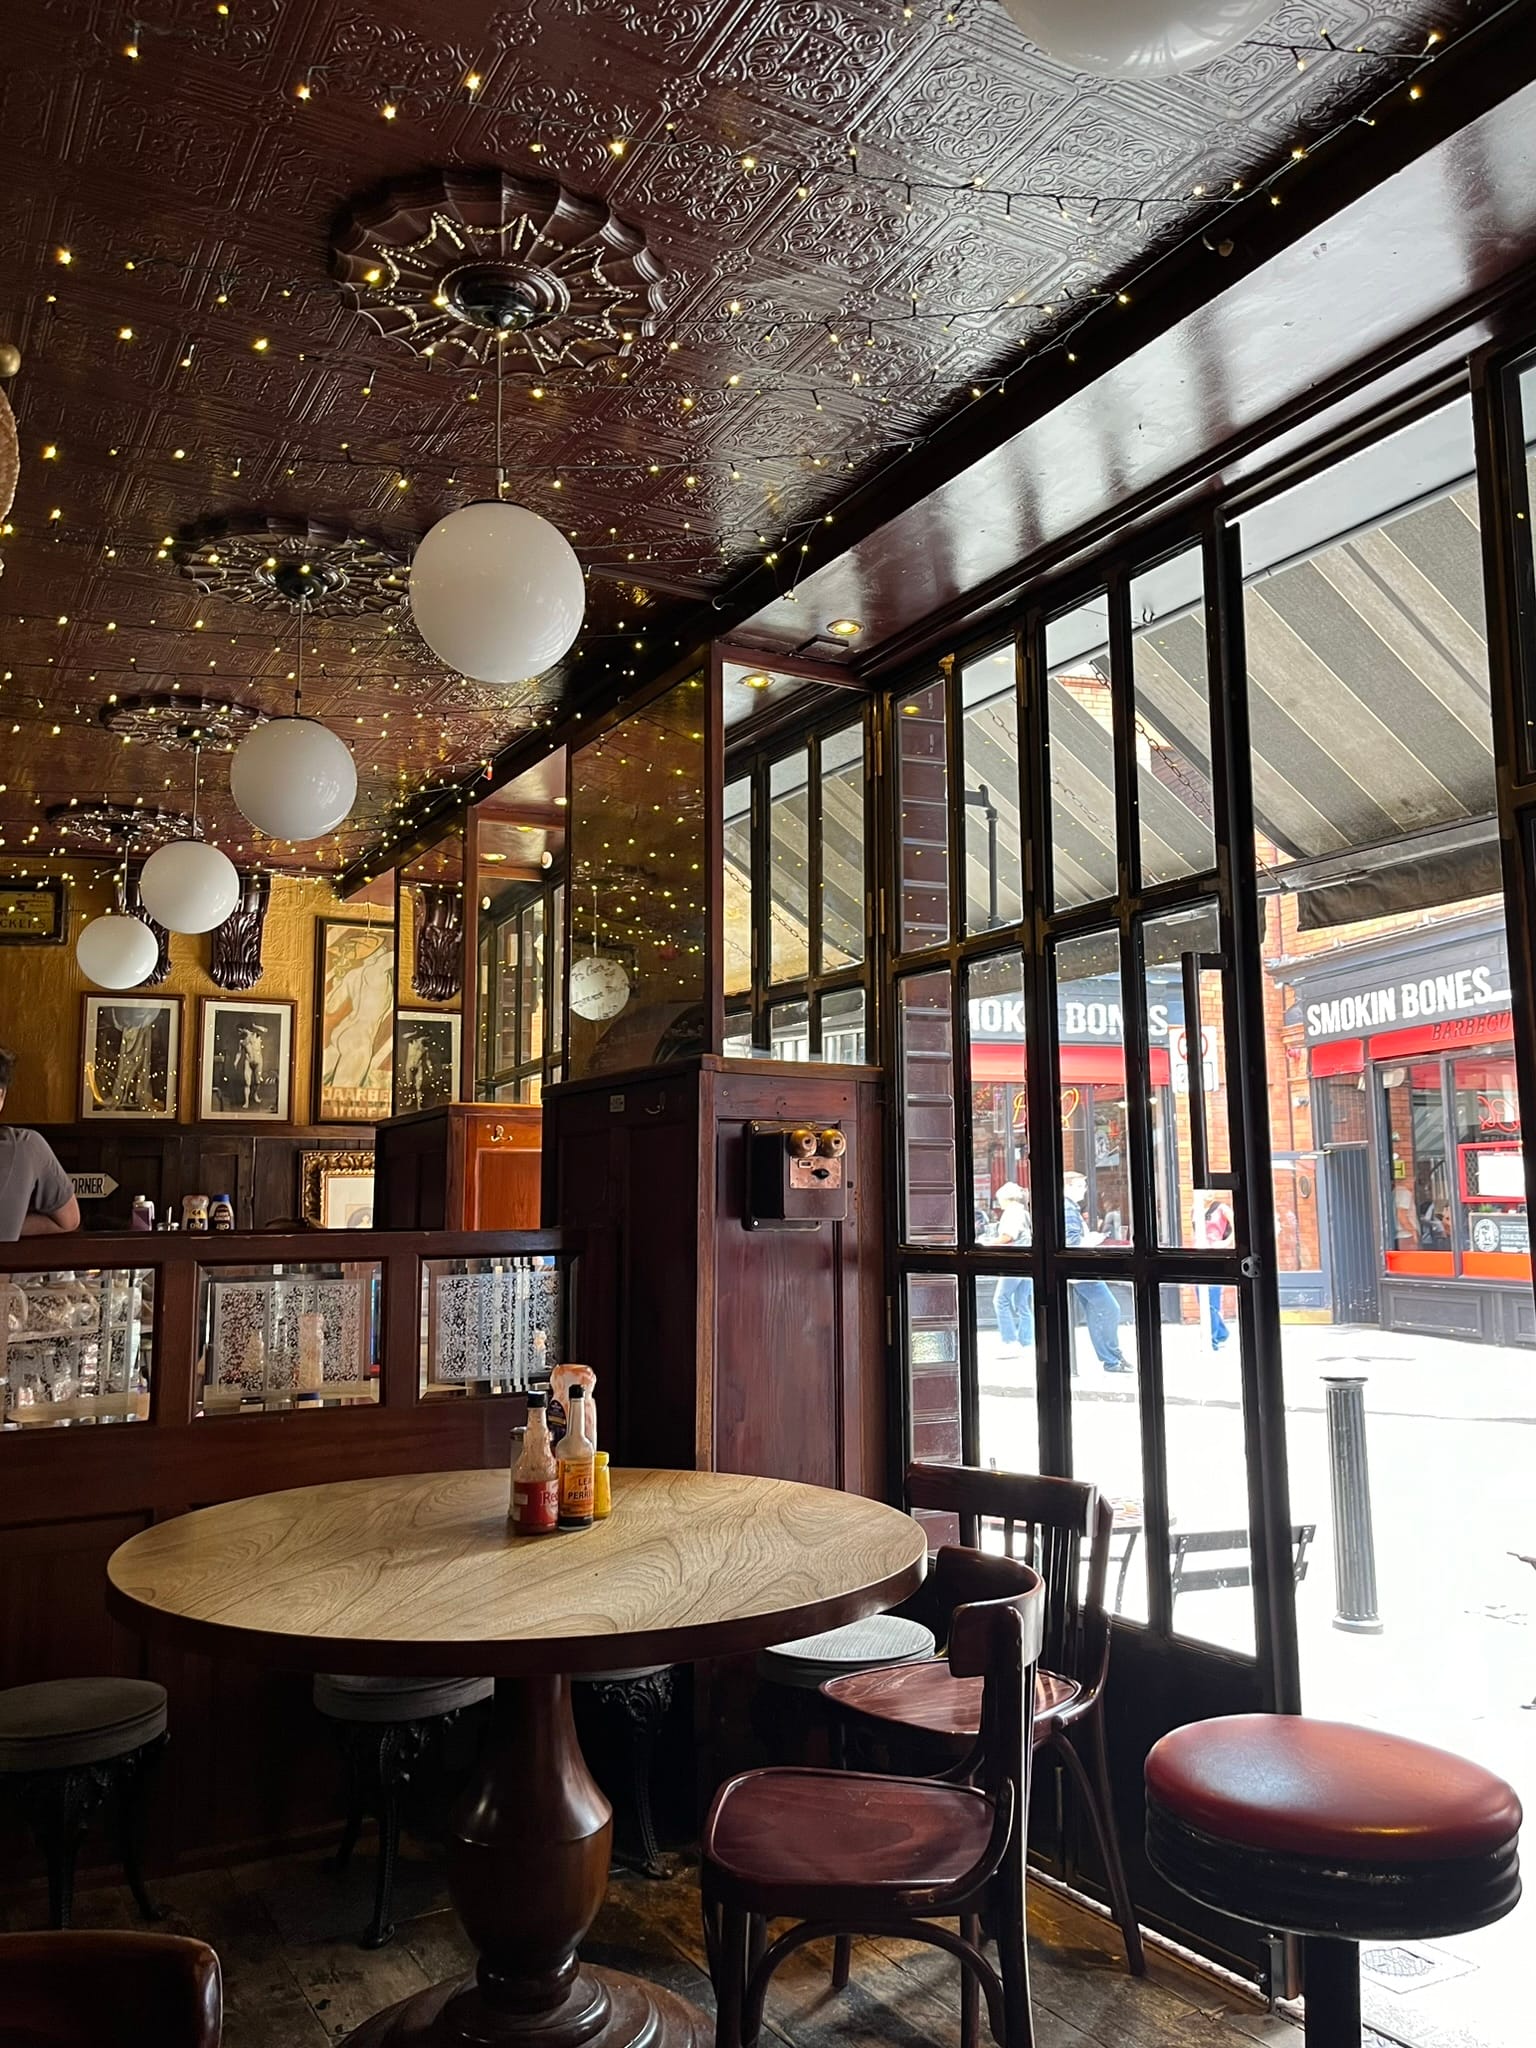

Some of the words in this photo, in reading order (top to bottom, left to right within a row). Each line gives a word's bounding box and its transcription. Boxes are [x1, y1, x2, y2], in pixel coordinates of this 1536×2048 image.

[1065, 1001, 1168, 1037] BONS
[1306, 987, 1397, 1036] SMOKIN
[1401, 966, 1494, 1020] BONES
[71, 1177, 103, 1194] ORNER
